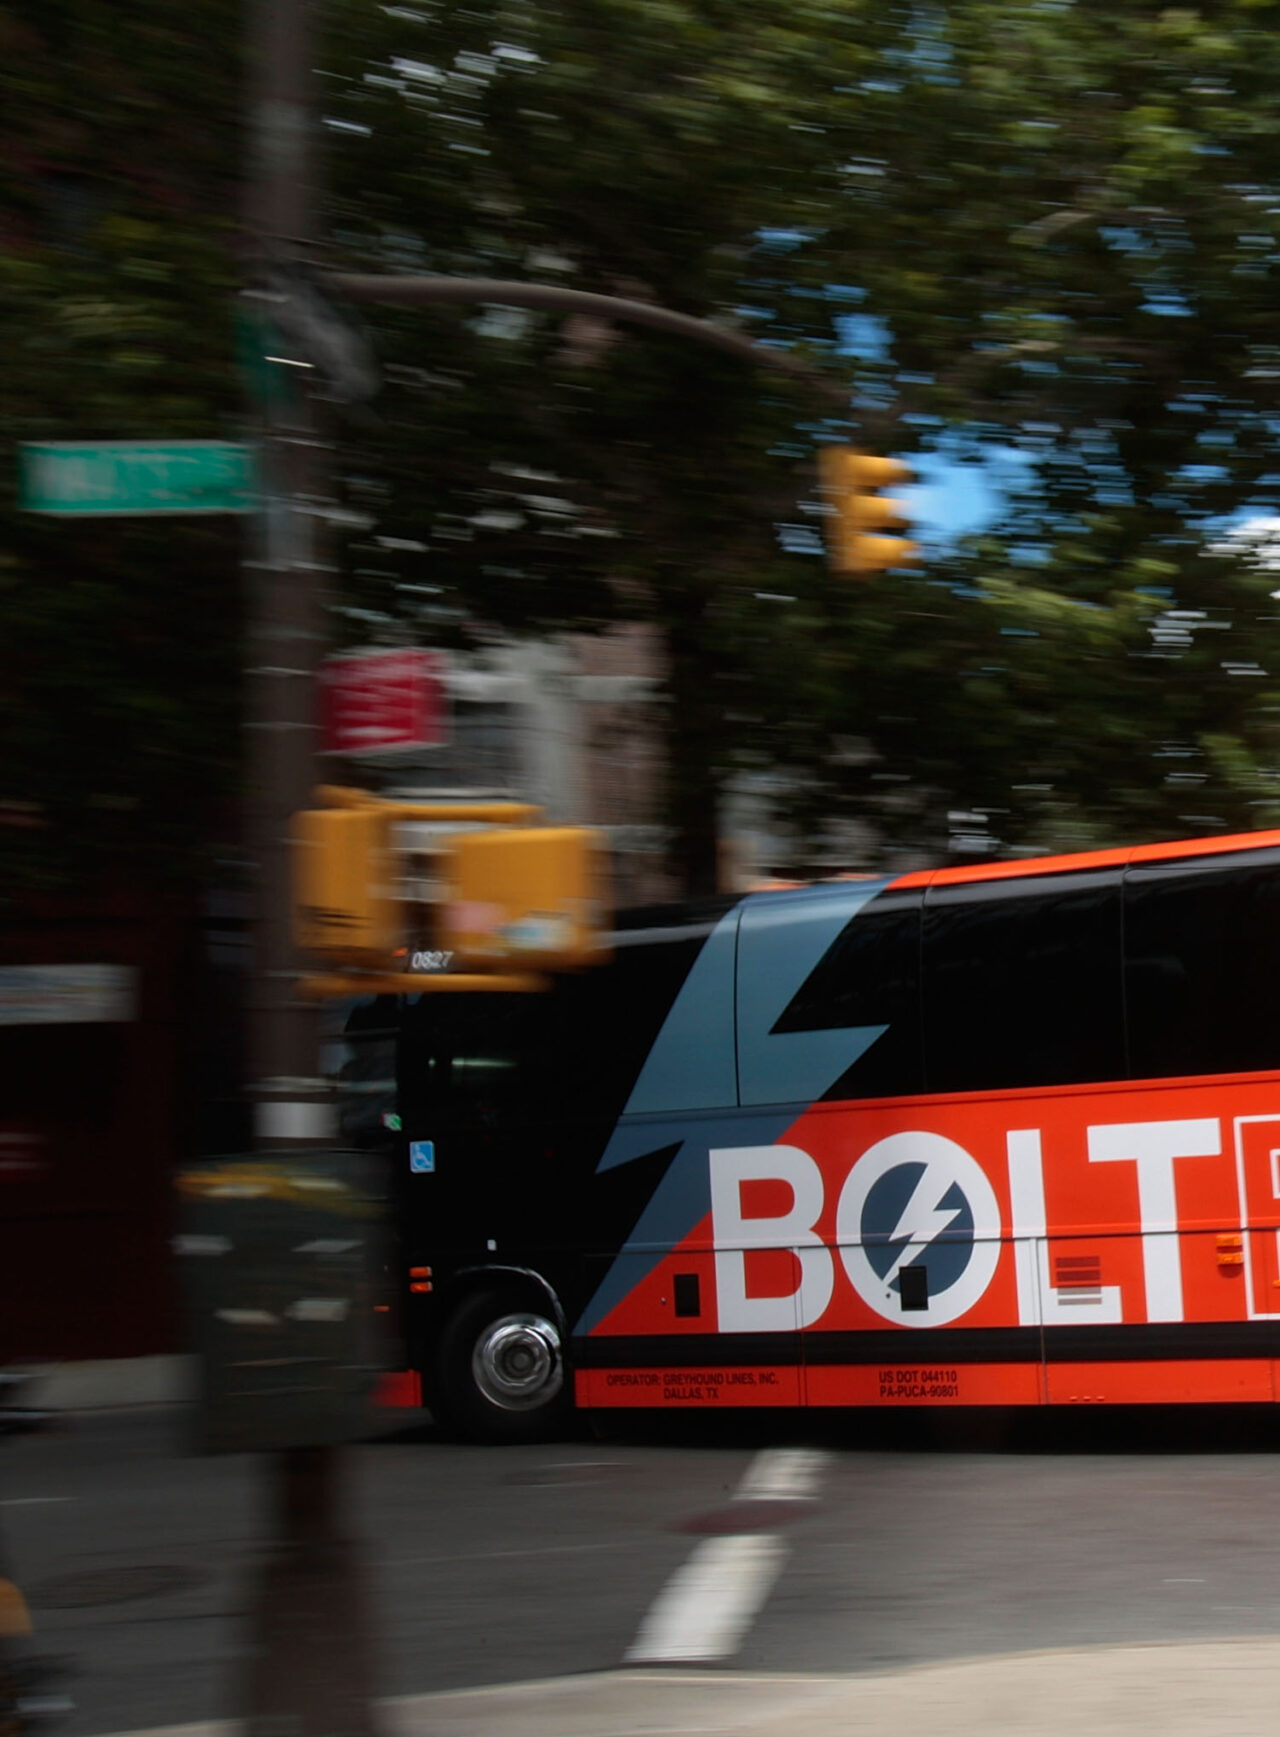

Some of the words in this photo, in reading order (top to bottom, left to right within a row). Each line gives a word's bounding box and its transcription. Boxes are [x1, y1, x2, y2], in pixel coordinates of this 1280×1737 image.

[412, 950, 455, 969] 0827
[606, 1374, 660, 1386] OPERATOR:
[663, 1373, 724, 1385] GREYHOUND
[726, 1373, 757, 1385] LINES,
[759, 1373, 779, 1385] INC.
[880, 1371, 894, 1383] US
[896, 1370, 919, 1383] DOT
[921, 1370, 957, 1382] 044110
[706, 1387, 719, 1398] TX
